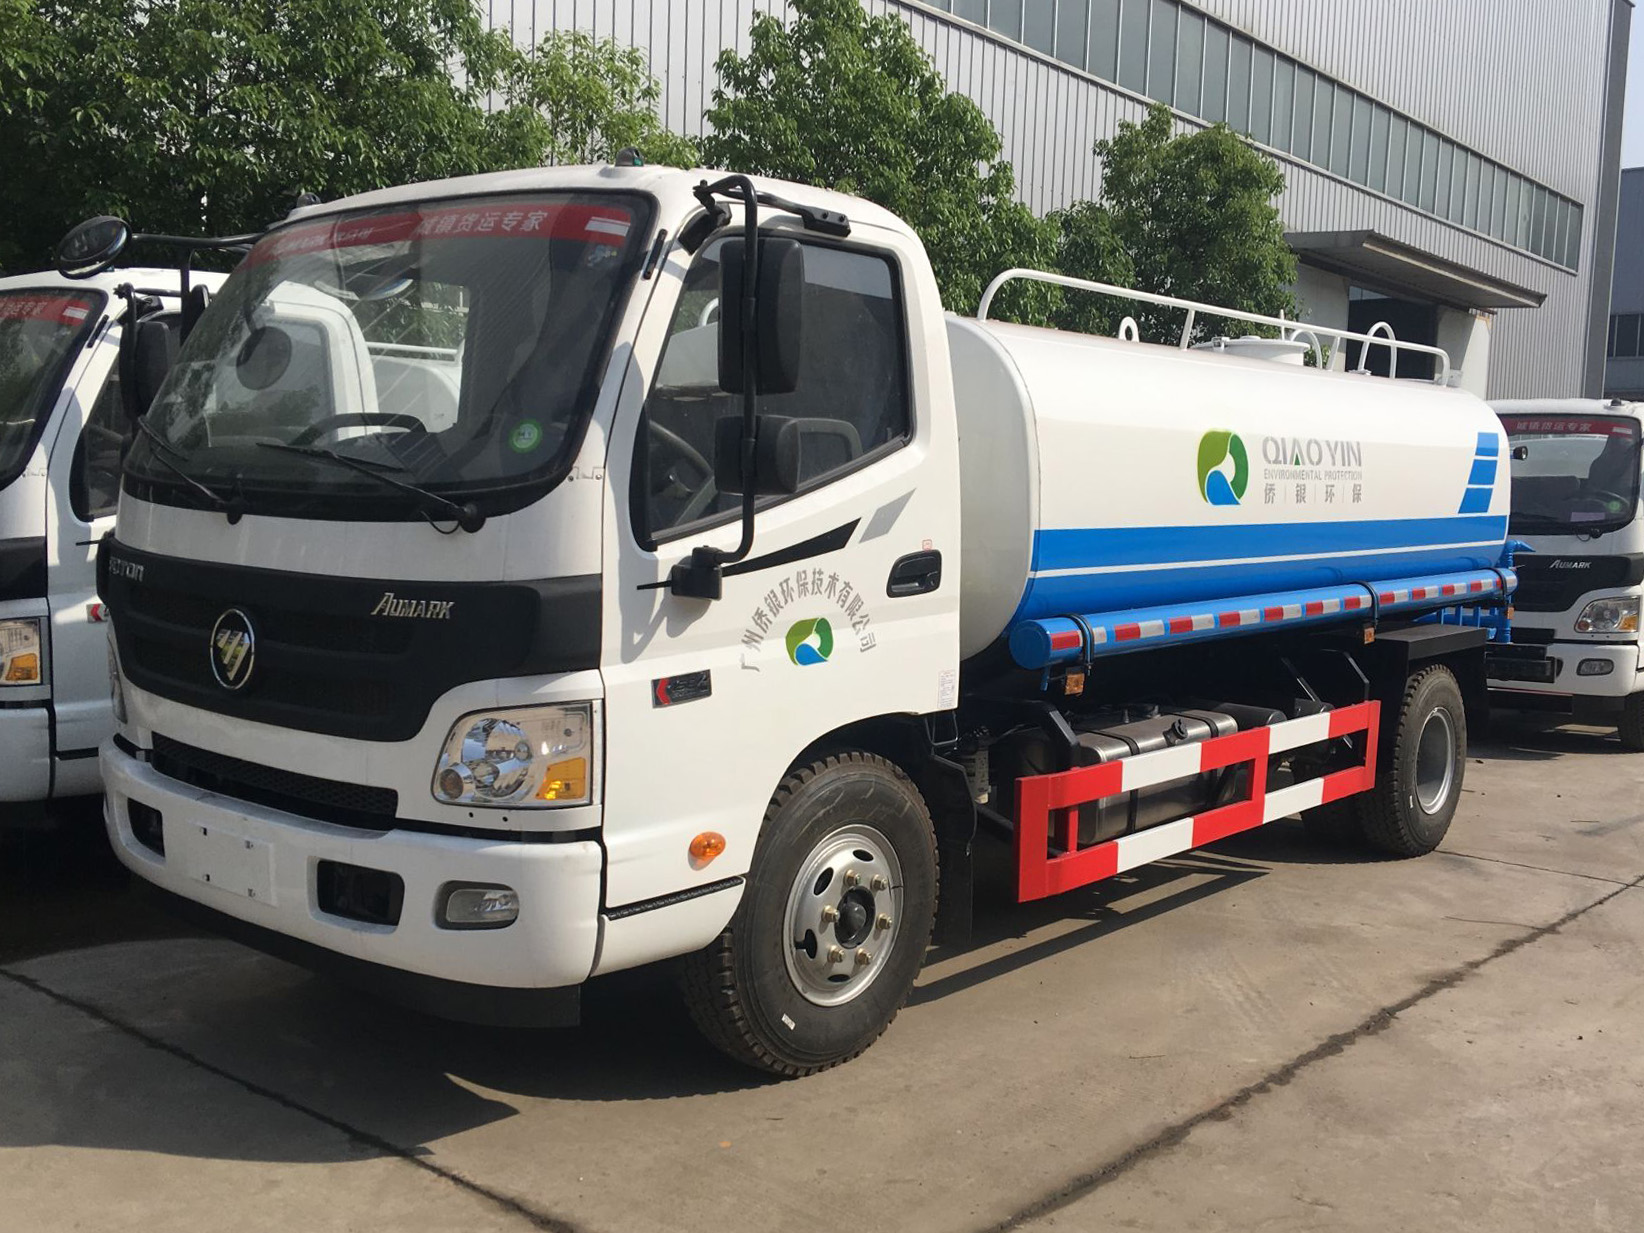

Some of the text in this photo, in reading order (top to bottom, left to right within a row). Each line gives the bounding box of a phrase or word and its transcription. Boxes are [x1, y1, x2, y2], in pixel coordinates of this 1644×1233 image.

[1264, 468, 1363, 481] ENVIRONMENTAL PROTECTION
[740, 568, 877, 672] 广州侨银环保技术有限公司
